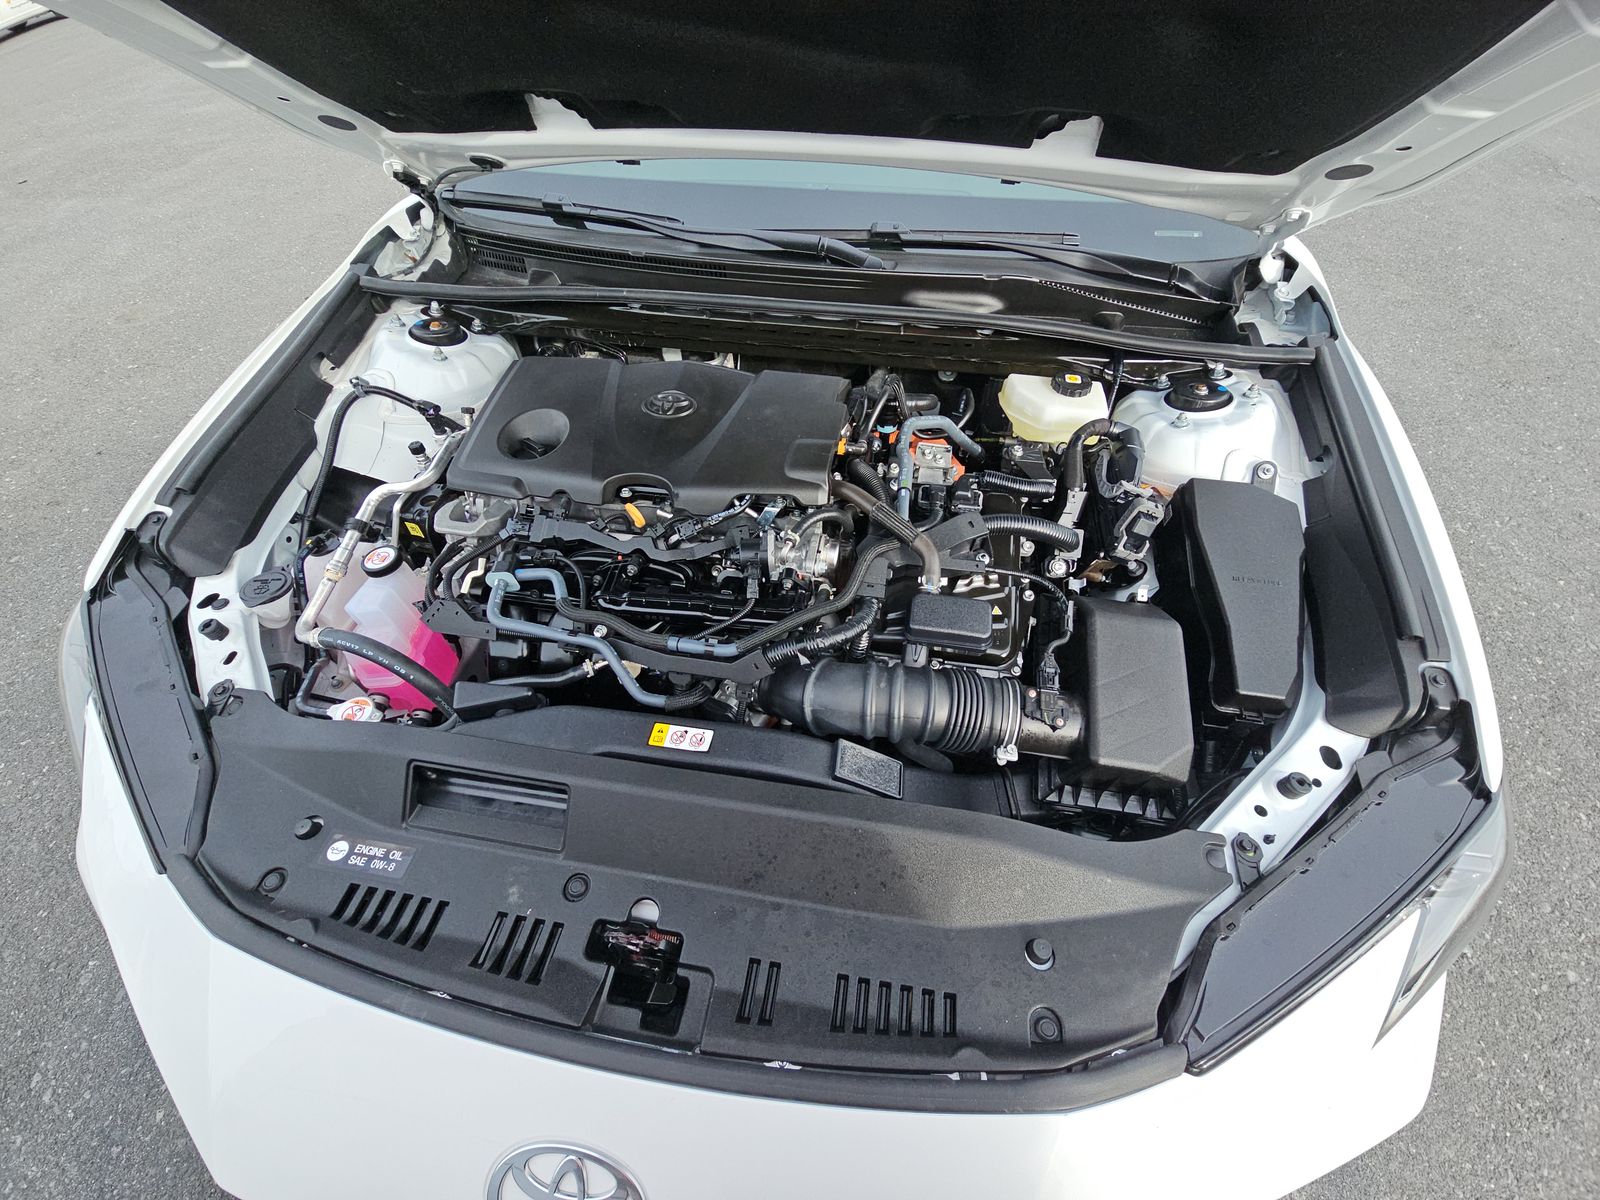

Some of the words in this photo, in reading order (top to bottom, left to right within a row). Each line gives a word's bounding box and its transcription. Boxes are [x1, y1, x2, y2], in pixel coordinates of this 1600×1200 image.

[354, 844, 386, 857] ENGINE
[389, 850, 402, 860] OIL
[348, 855, 367, 865] SAE
[370, 860, 395, 871] 0W-8
